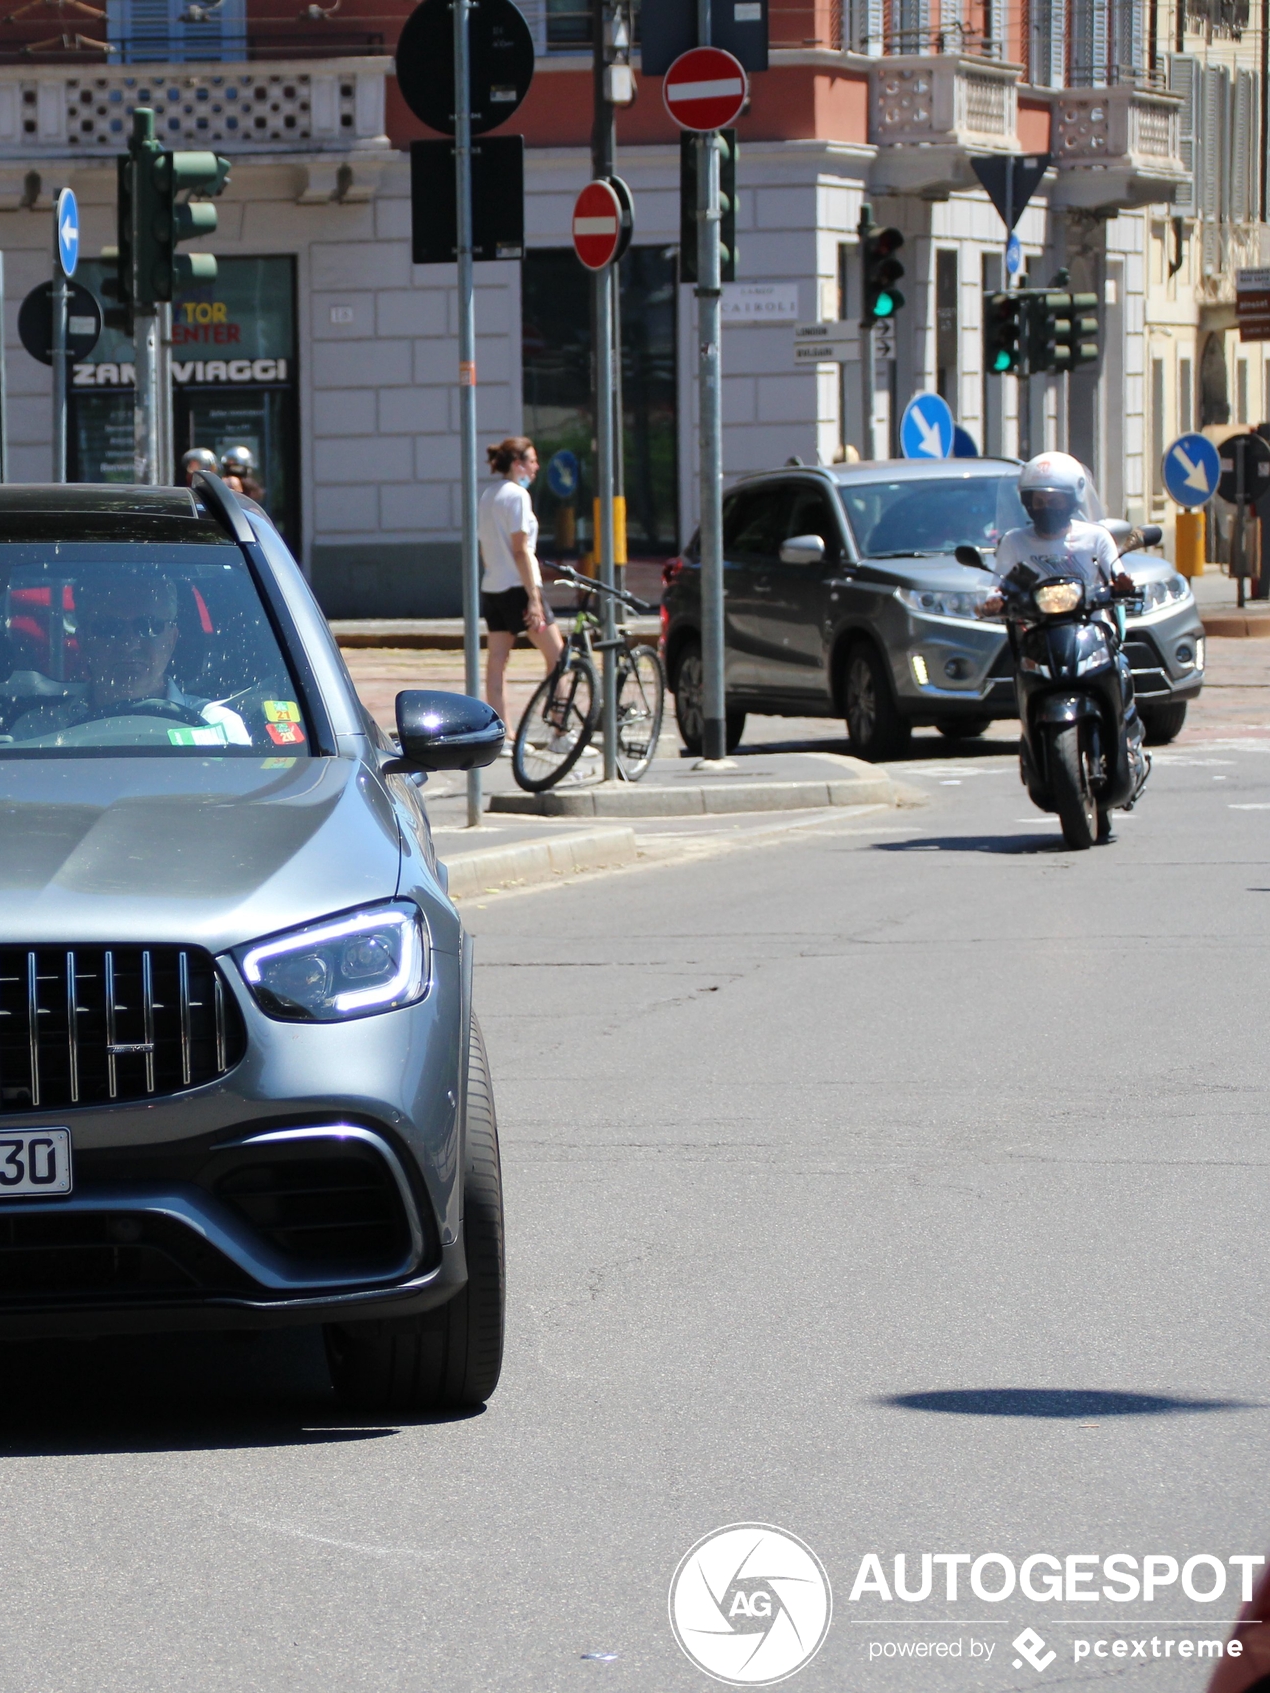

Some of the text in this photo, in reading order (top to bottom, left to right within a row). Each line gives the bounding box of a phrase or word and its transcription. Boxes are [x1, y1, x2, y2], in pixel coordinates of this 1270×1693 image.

[172, 323, 241, 345] ENTER
[73, 358, 288, 386] ZAN VIAGGI
[276, 711, 291, 720] 21
